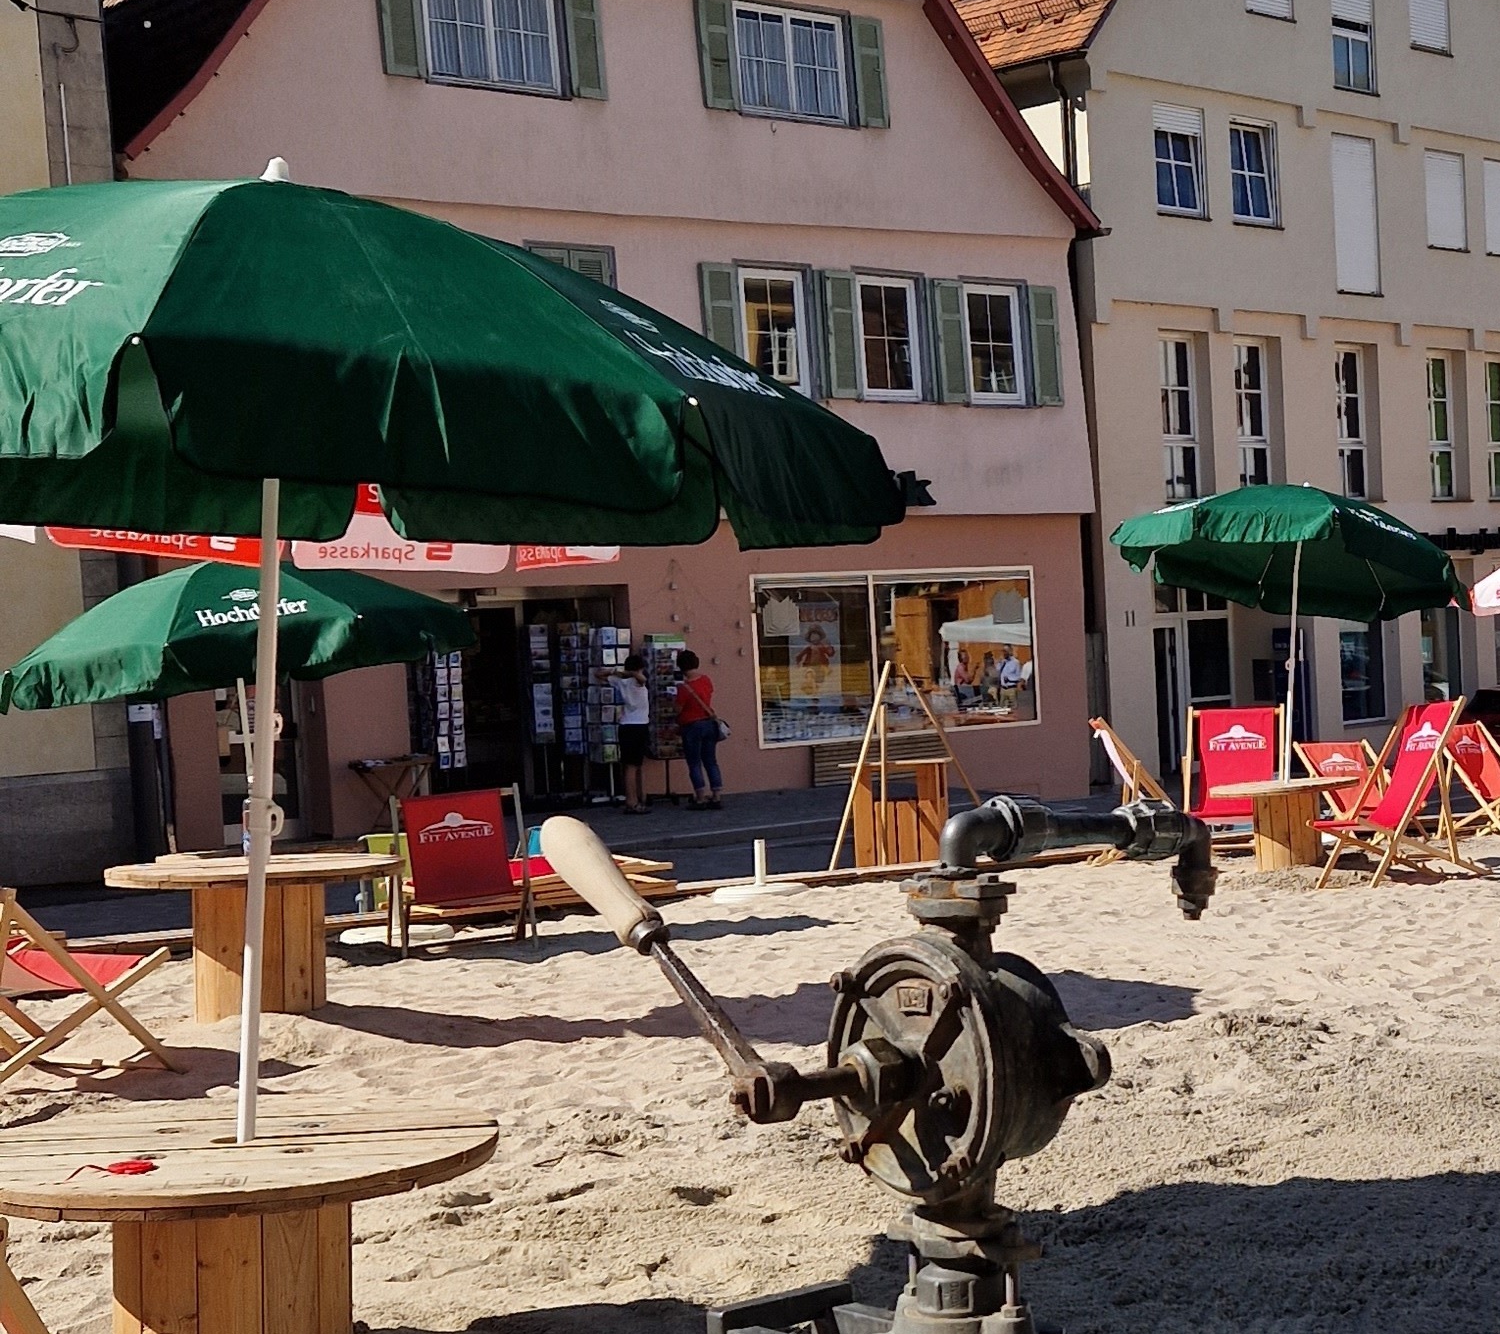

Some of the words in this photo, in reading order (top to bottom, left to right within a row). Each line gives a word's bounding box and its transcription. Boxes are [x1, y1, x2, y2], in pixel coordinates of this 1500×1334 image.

[194, 598, 308, 627] Hochdrfer
[1208, 741, 1227, 752] FIT
[1228, 739, 1267, 750] AVENUE
[419, 831, 442, 844] FIT
[445, 825, 495, 842] AVENUE
